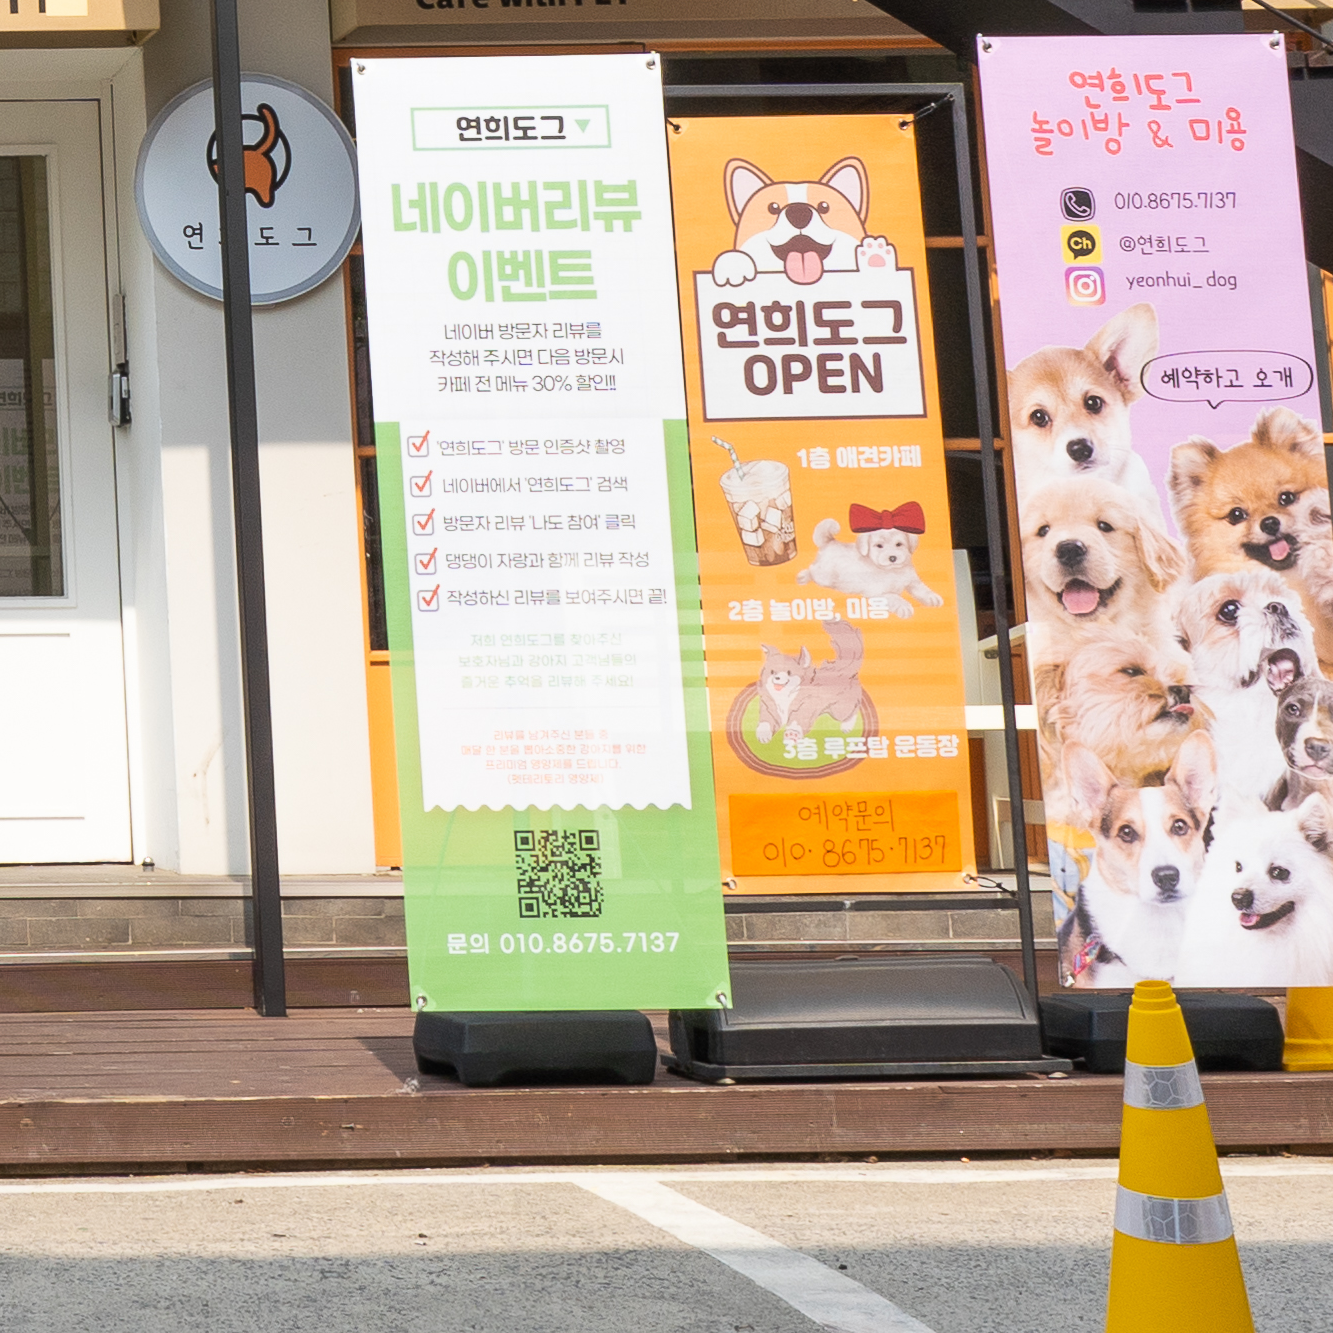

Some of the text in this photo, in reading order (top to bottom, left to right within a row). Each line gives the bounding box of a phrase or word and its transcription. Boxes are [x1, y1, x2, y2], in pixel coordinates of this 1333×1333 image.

[1068, 67, 1201, 111] 연희도그
[456, 115, 567, 142] 연희도그
[1031, 106, 1247, 156] 놀이방 & 미용
[391, 179, 642, 234] 네이버리뷰
[1114, 192, 1237, 210] 010.8675.7137
[183, 222, 318, 250] 연도그
[1070, 237, 1093, 251] Ch
[1119, 235, 1210, 256] @연희도그
[447, 249, 598, 302] 이벤트
[444, 321, 602, 340] 네이버 방문자 리뷰를
[712, 300, 907, 349] 연희도그
[429, 347, 624, 367] 작성해 주시면 다음 방문시
[437, 374, 617, 393] 카페 전 메뉴 30% 할인!!
[743, 352, 884, 396] OPEN
[1161, 367, 1293, 390] 예약하고 오개
[508, 439, 540, 456] 방문
[543, 438, 591, 455] 인증샷
[594, 438, 626, 455] 촬영
[796, 445, 922, 470] 1층 애견카페
[442, 477, 522, 494] 네이버에서
[596, 476, 628, 492] 검색
[443, 515, 491, 532] 방문자
[494, 514, 526, 531] 리뷰
[605, 514, 636, 530] 클릭
[445, 551, 650, 569] 댕댕이 자랑과 함께 리뷰 작성
[446, 588, 668, 606] 작성하신 리뷰를 보여주시면 끝!
[728, 597, 890, 622] 2층 놀이방, 미용
[782, 734, 960, 760] 3층 루프탑 운동장
[797, 799, 895, 833] 예약문의
[446, 932, 680, 955] 문의 010.8675.7137
